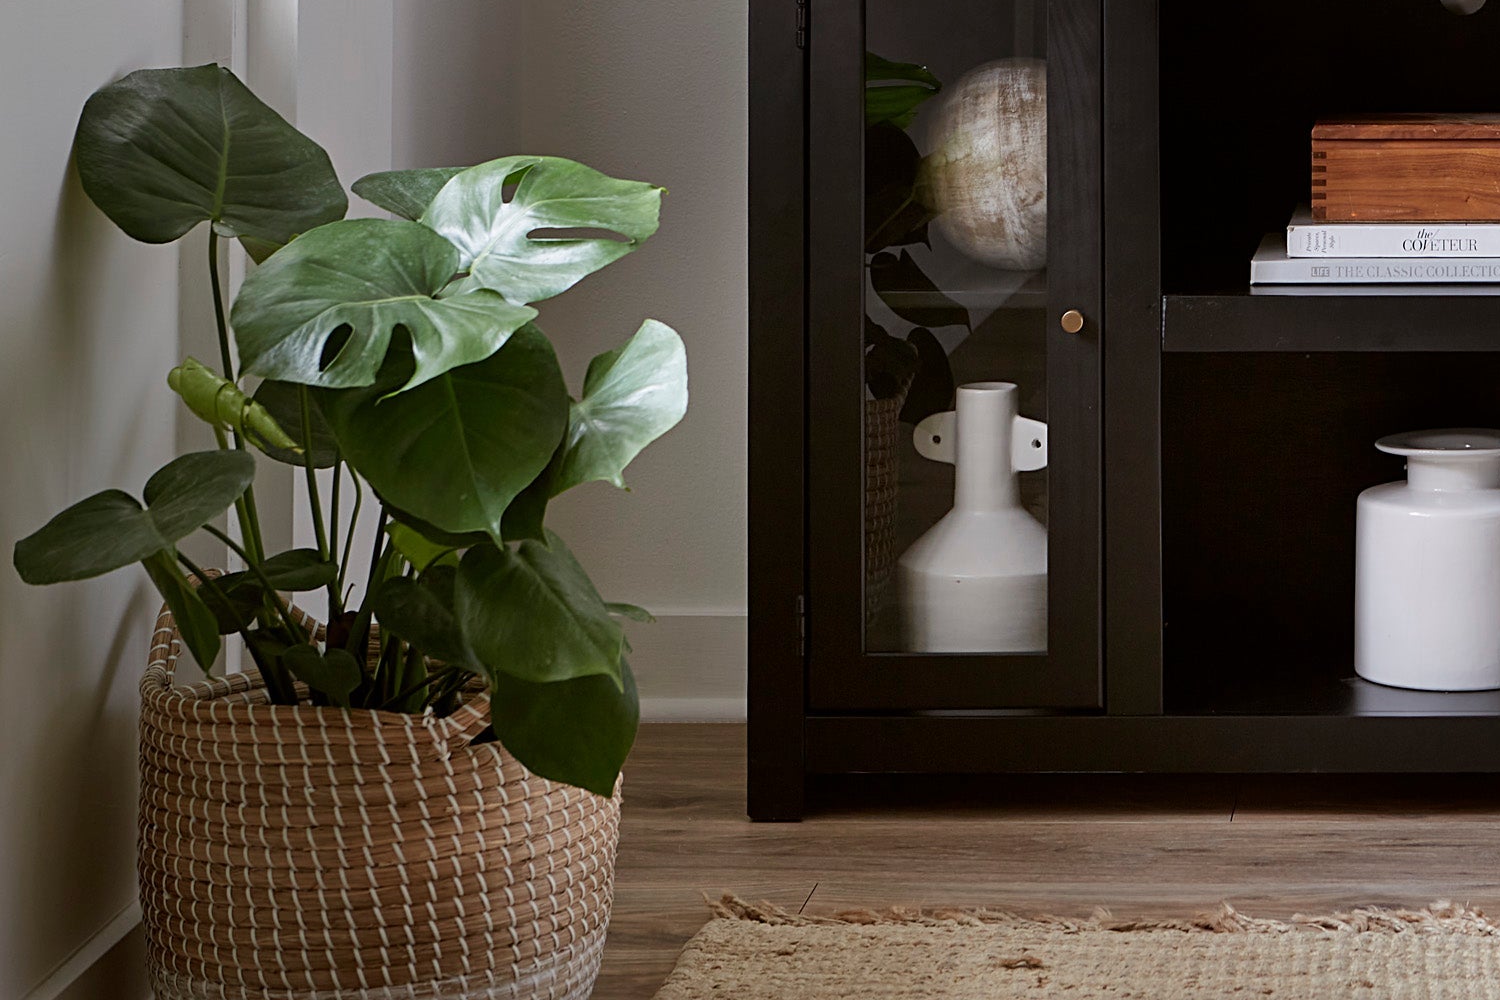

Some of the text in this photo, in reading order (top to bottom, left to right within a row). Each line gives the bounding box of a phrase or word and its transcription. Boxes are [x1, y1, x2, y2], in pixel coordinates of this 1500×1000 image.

[1417, 228, 1433, 239] the
[1312, 267, 1329, 277] LIFE
[1336, 266, 1363, 277] THE
[1367, 266, 1423, 278] CLASSIC
